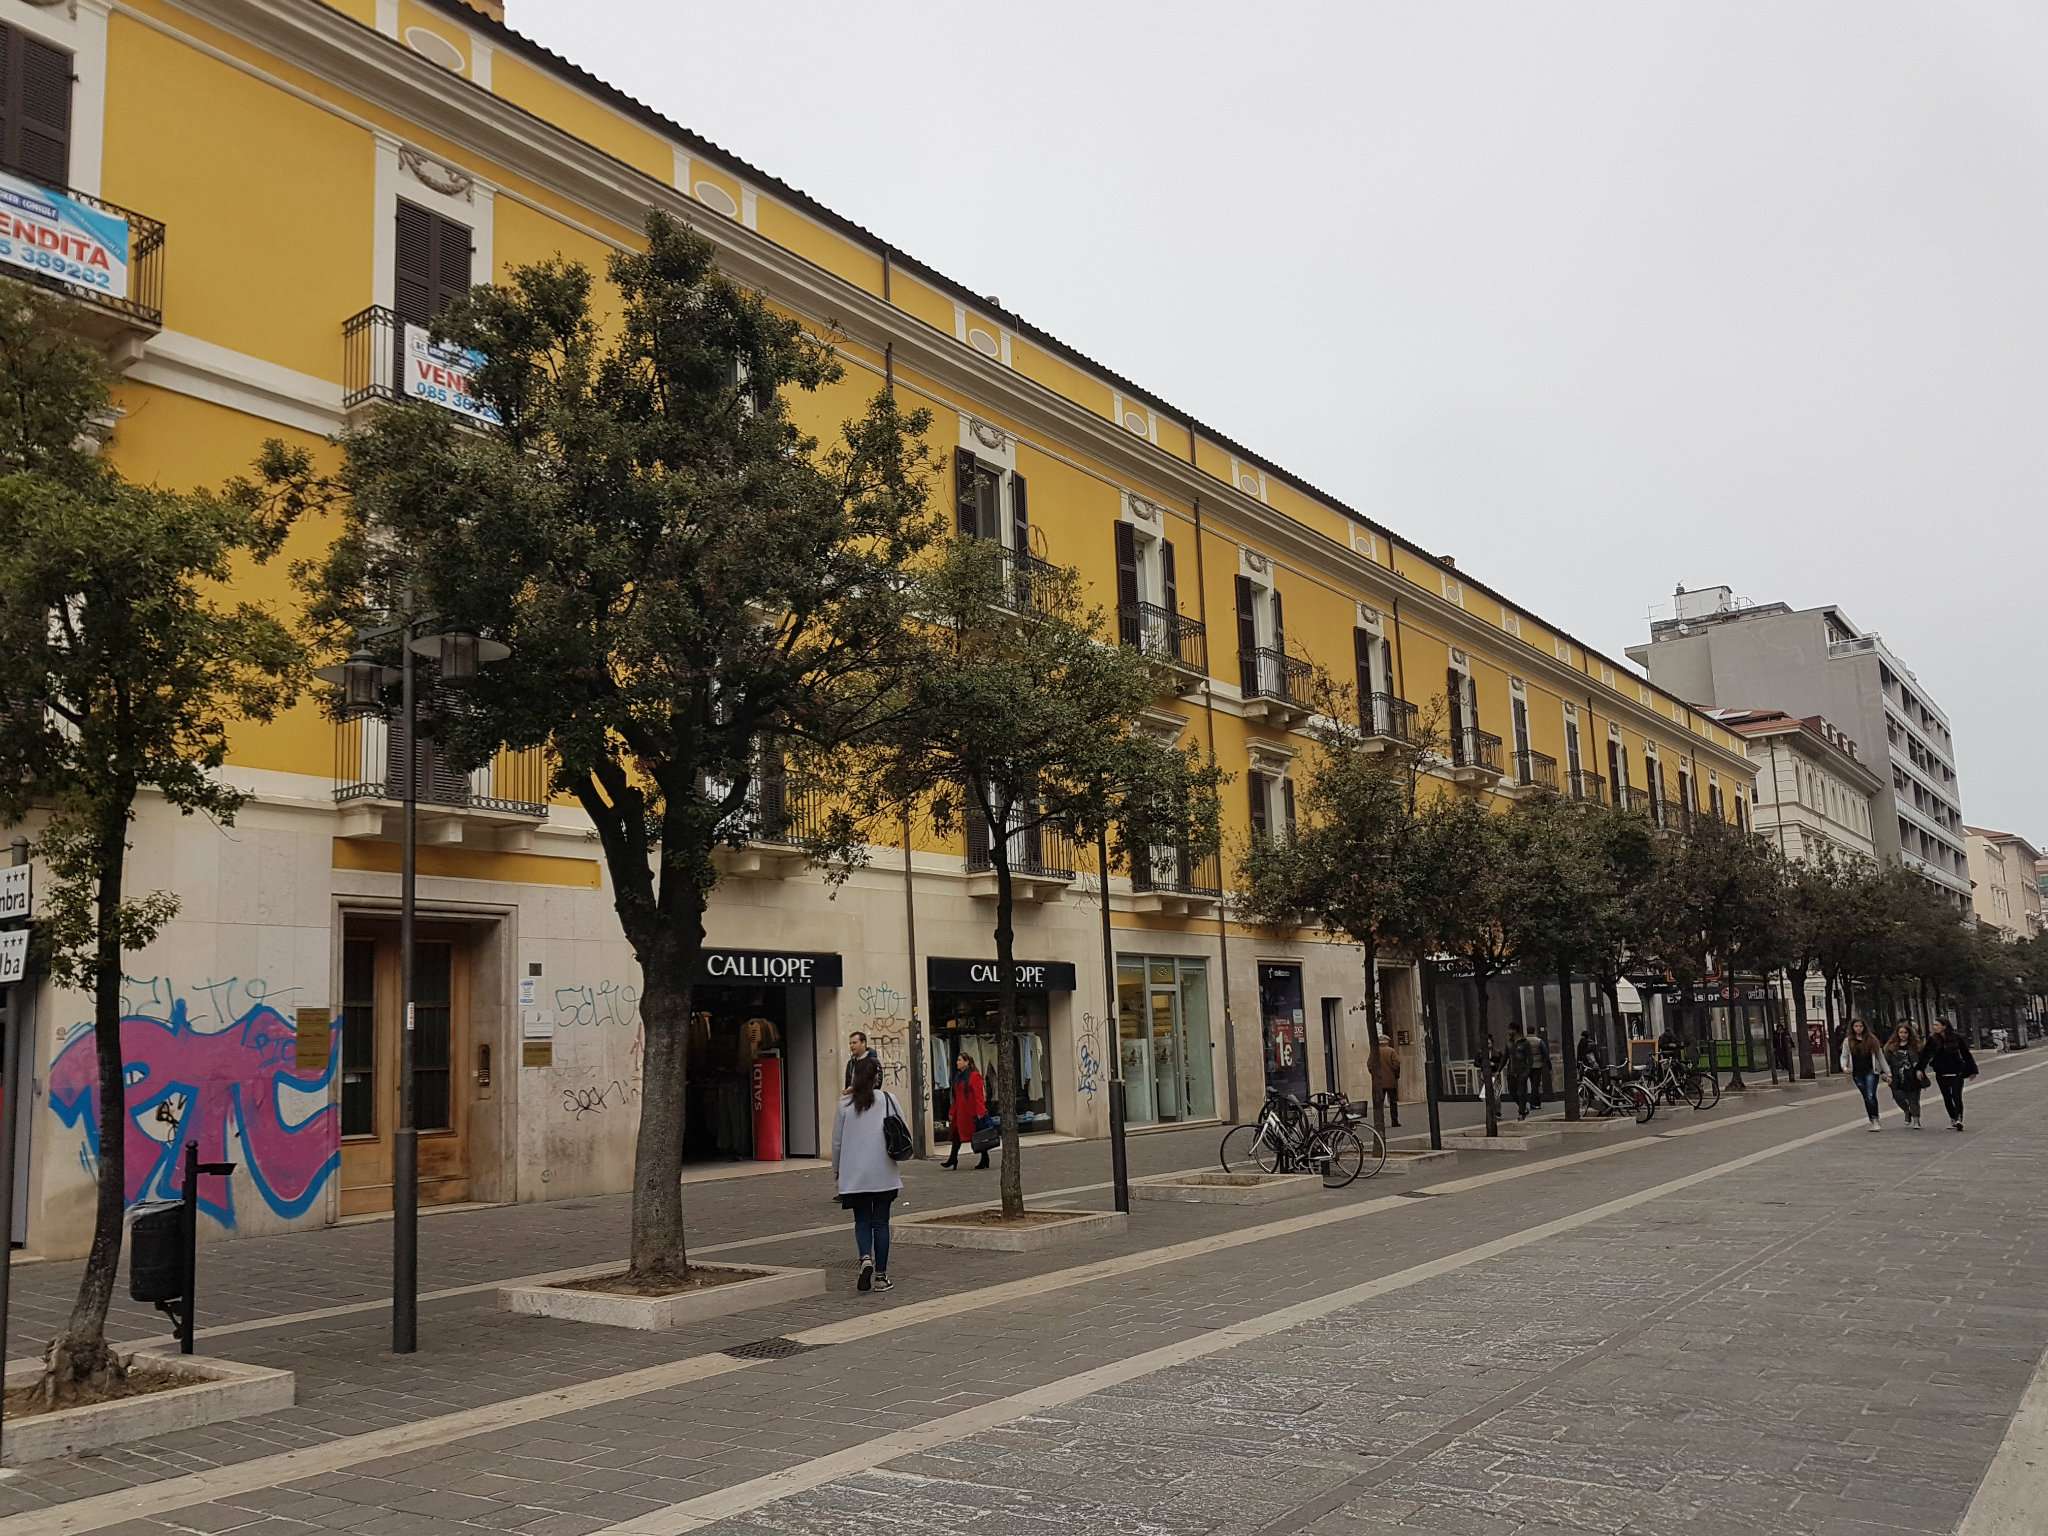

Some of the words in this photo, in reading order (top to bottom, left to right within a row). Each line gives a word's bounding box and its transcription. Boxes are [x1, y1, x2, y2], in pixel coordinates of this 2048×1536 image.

[417, 382, 447, 402] 085
[707, 955, 815, 978] CALLIOPE
[970, 964, 1046, 983] CALOPE
[752, 1063, 762, 1112] SALDI
